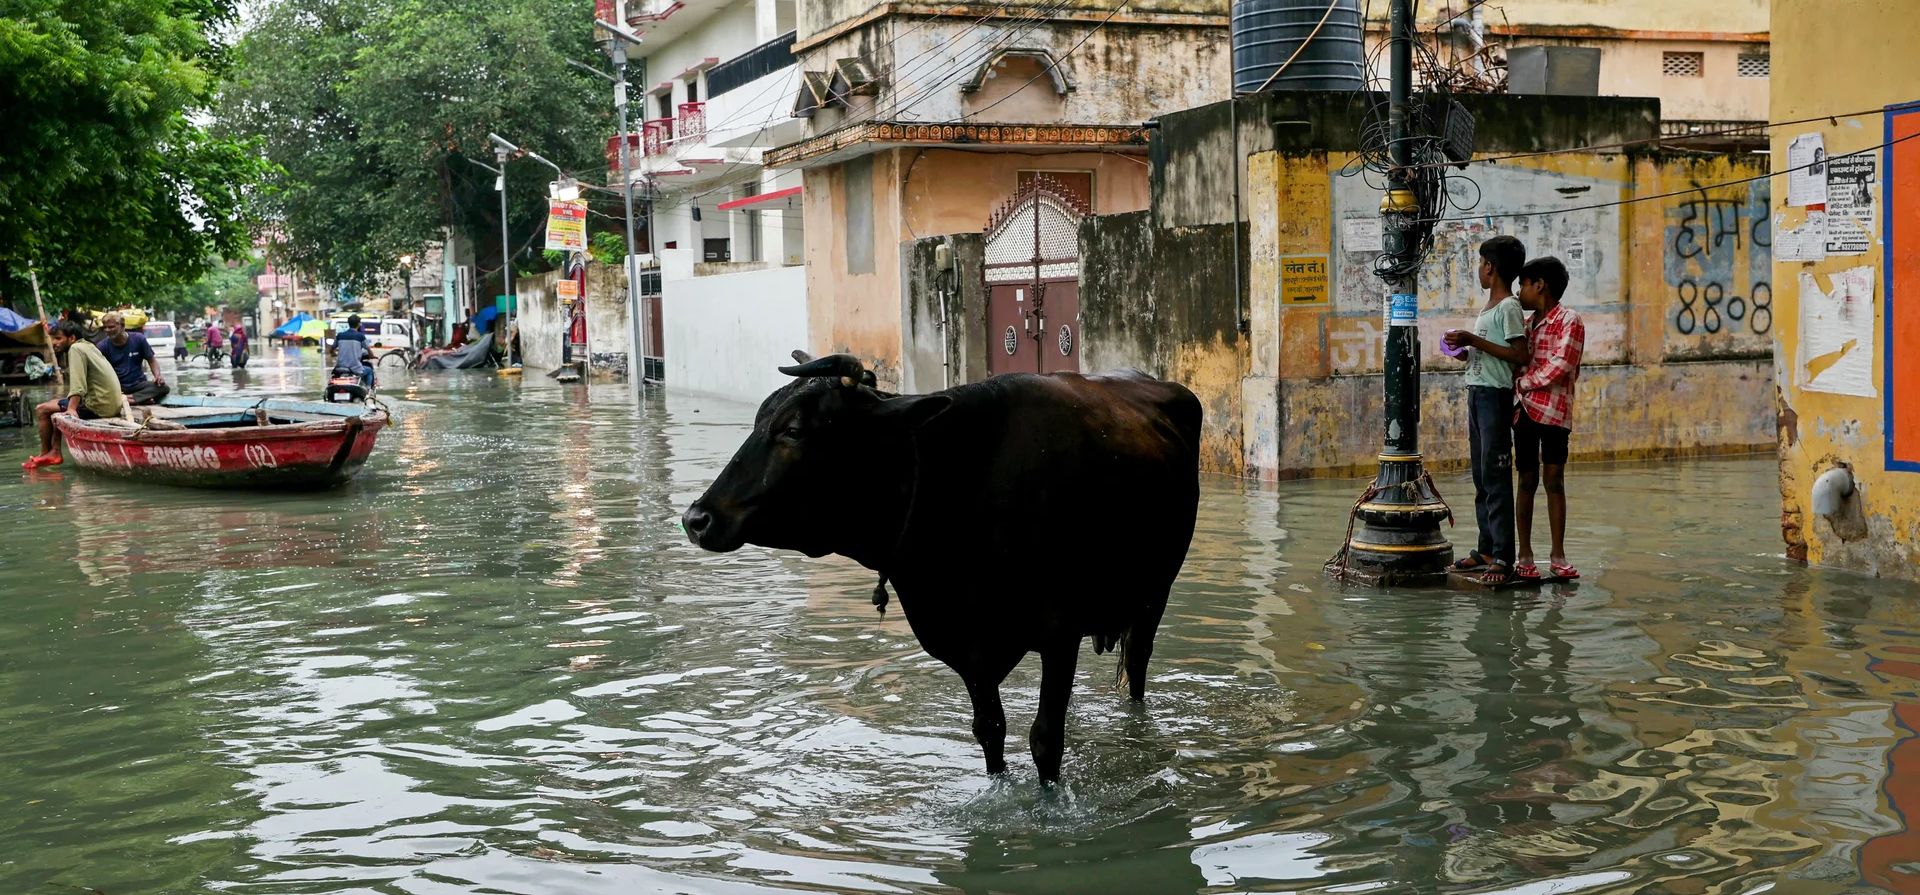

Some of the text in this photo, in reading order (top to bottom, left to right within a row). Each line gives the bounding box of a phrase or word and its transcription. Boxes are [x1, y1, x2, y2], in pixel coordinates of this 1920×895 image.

[1675, 179, 1745, 259] होम
[1284, 260, 1305, 274] लेन
[143, 445, 221, 470] zomato
[244, 443, 279, 469] (12)
